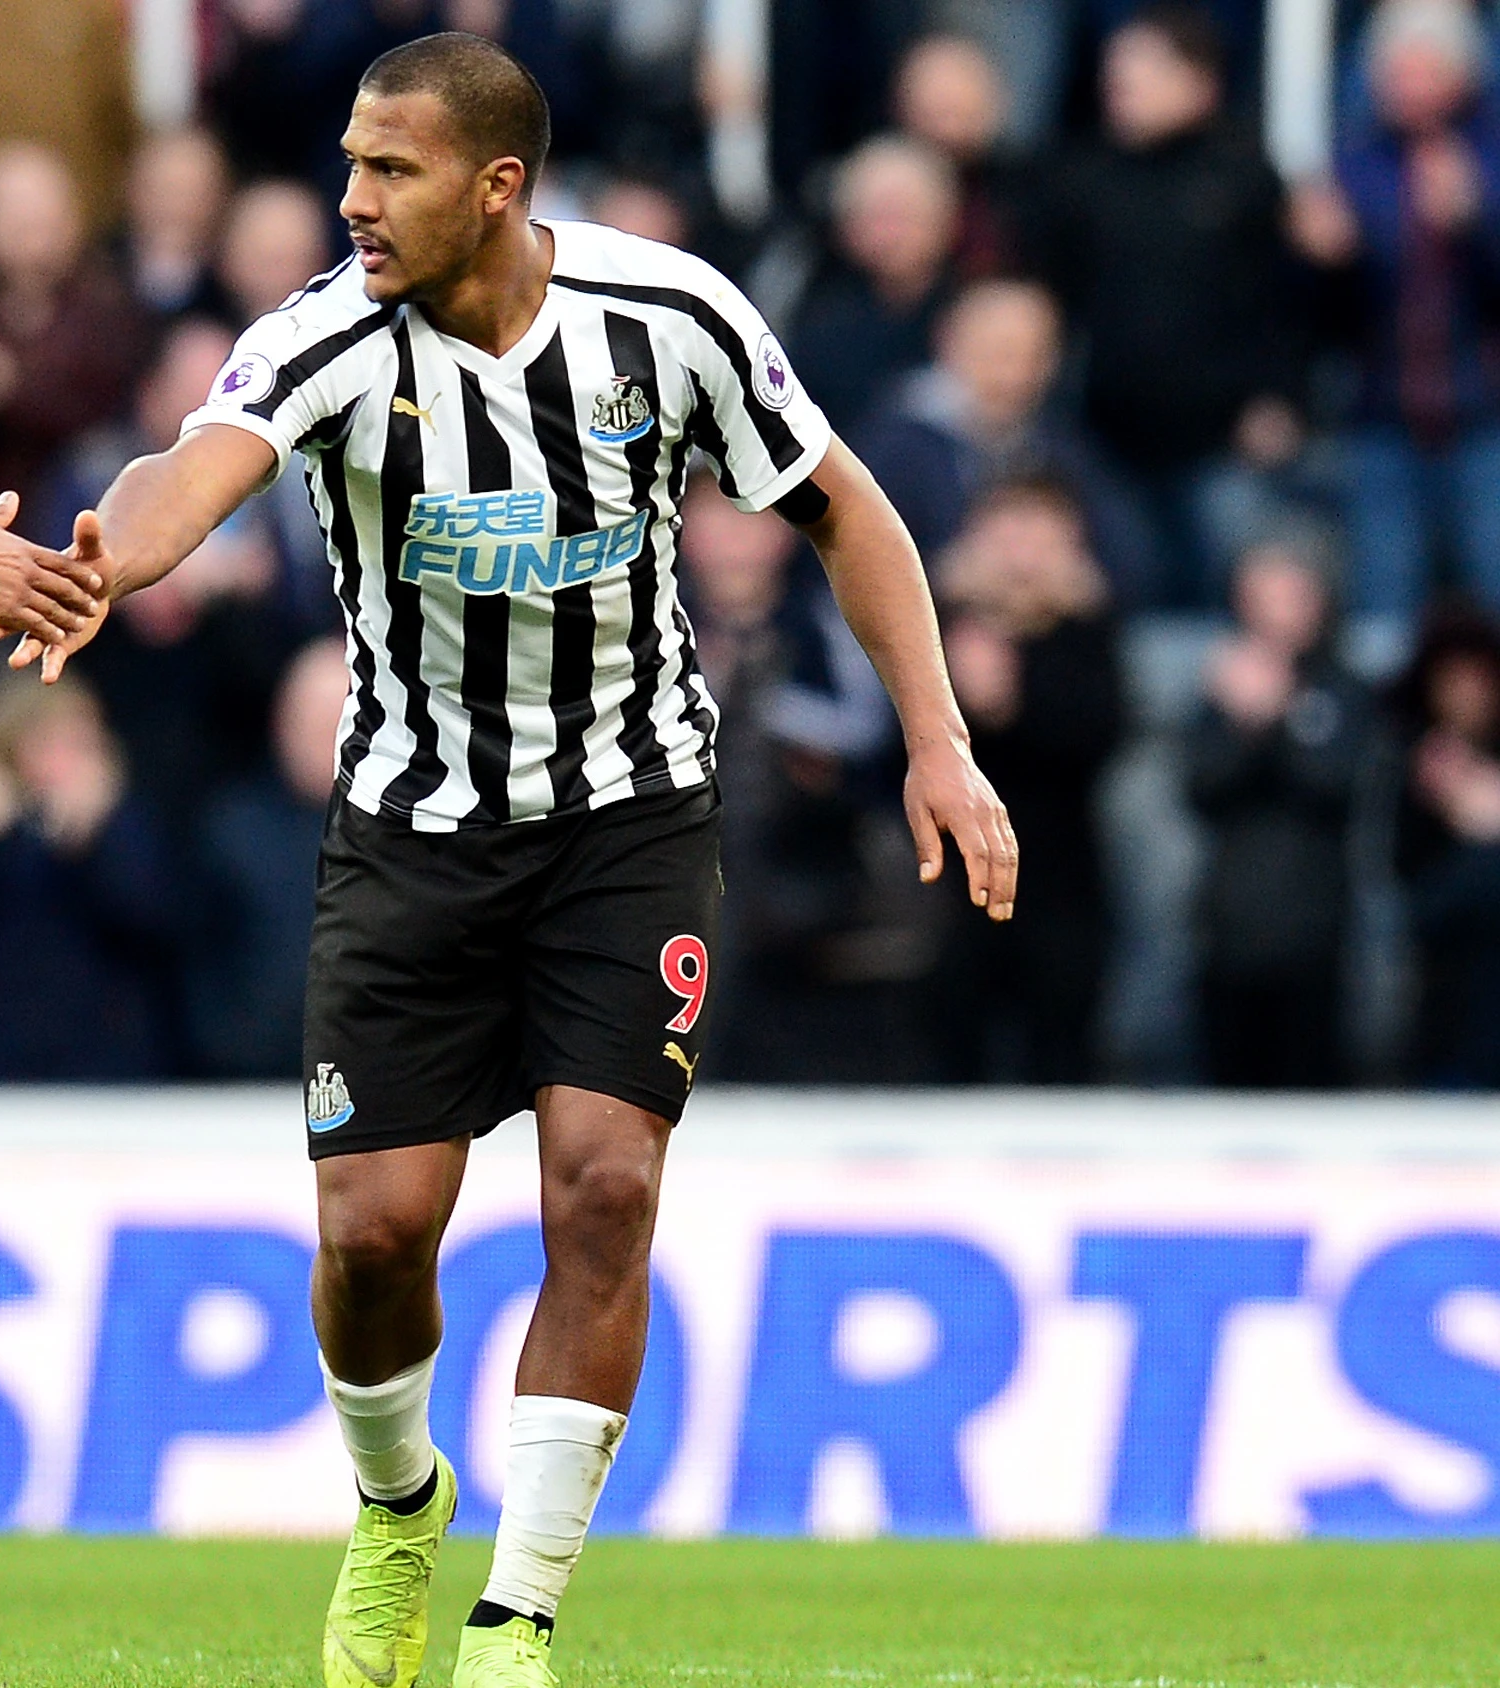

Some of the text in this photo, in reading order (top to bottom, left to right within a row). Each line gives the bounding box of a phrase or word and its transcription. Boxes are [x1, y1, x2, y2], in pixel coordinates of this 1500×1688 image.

[401, 508, 649, 594] FUN88
[406, 488, 548, 539] 乐天堂
[659, 933, 709, 1034] 9
